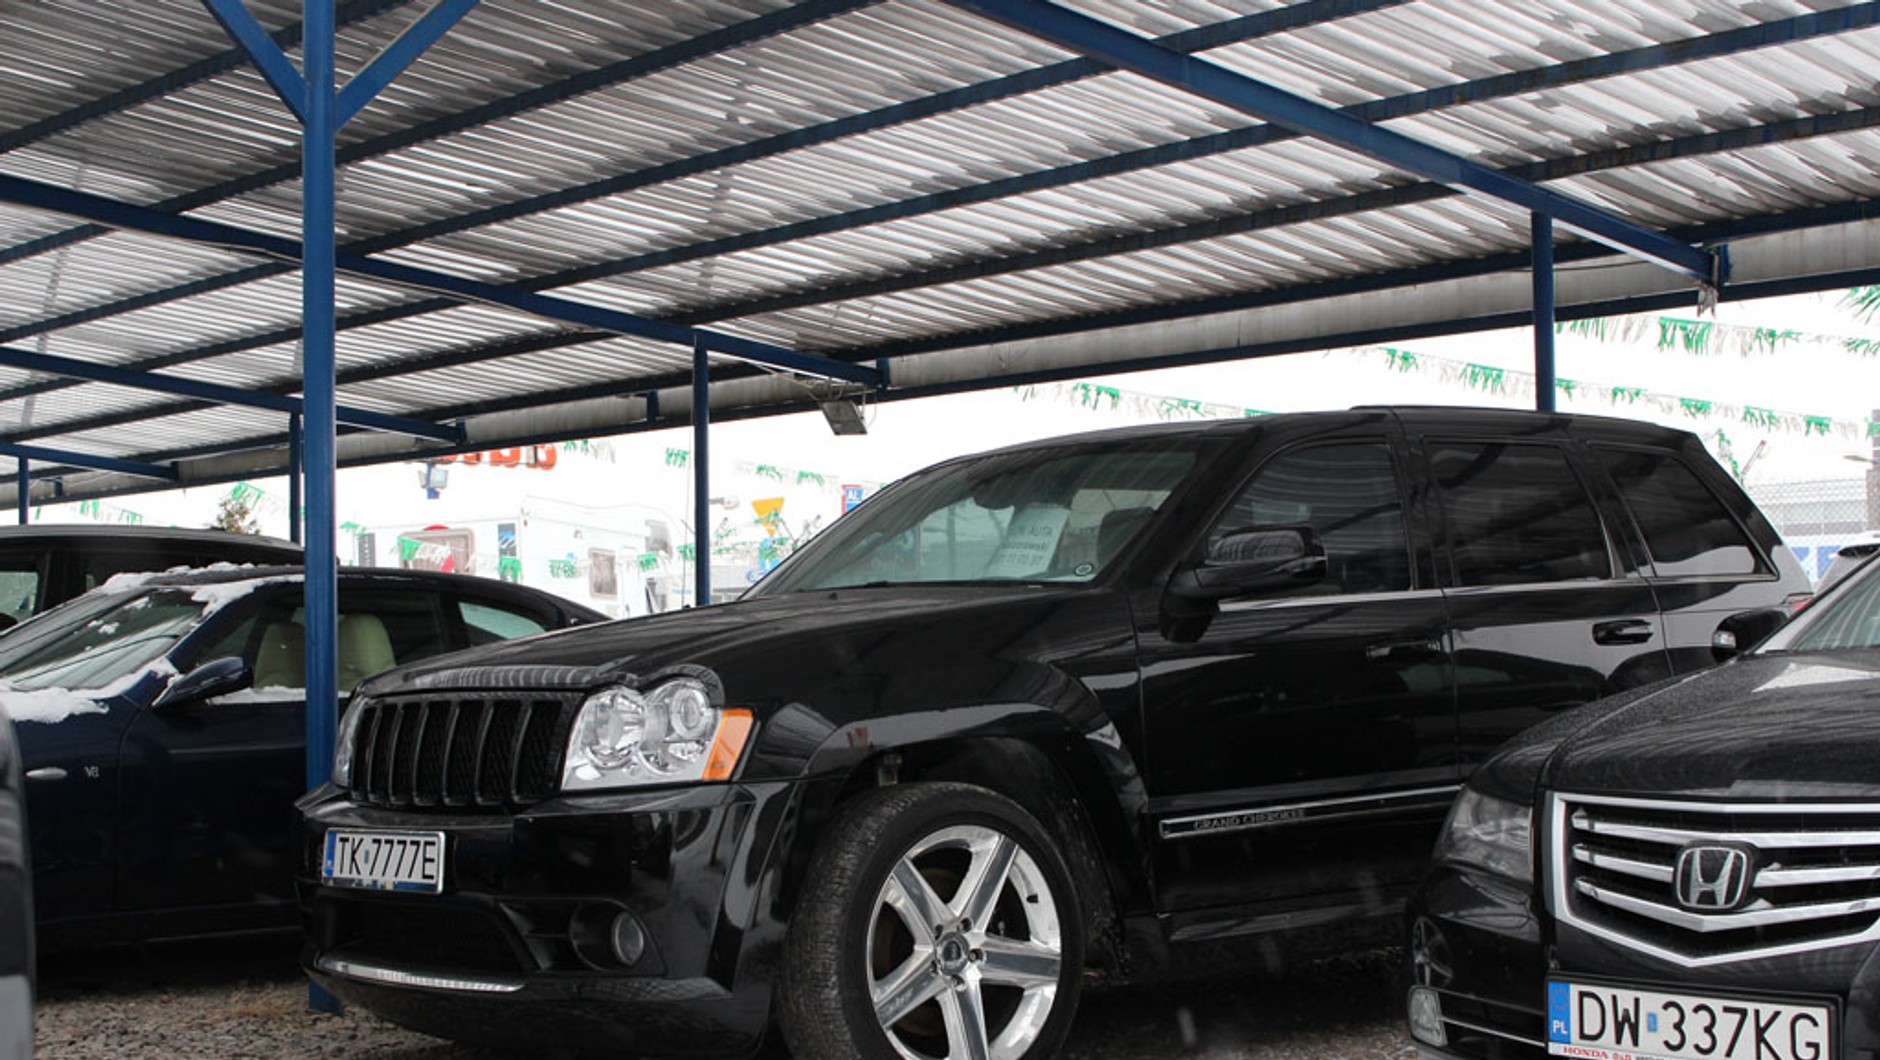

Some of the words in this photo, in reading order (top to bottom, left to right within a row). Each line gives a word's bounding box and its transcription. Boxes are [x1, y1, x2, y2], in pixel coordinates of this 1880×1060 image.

[340, 836, 364, 875] TK
[369, 839, 436, 880] 7777E
[1552, 1020, 1568, 1036] PL
[1578, 991, 1641, 1048] DW
[1661, 1001, 1821, 1060] 337KG
[1562, 1046, 1608, 1059] HONDA
